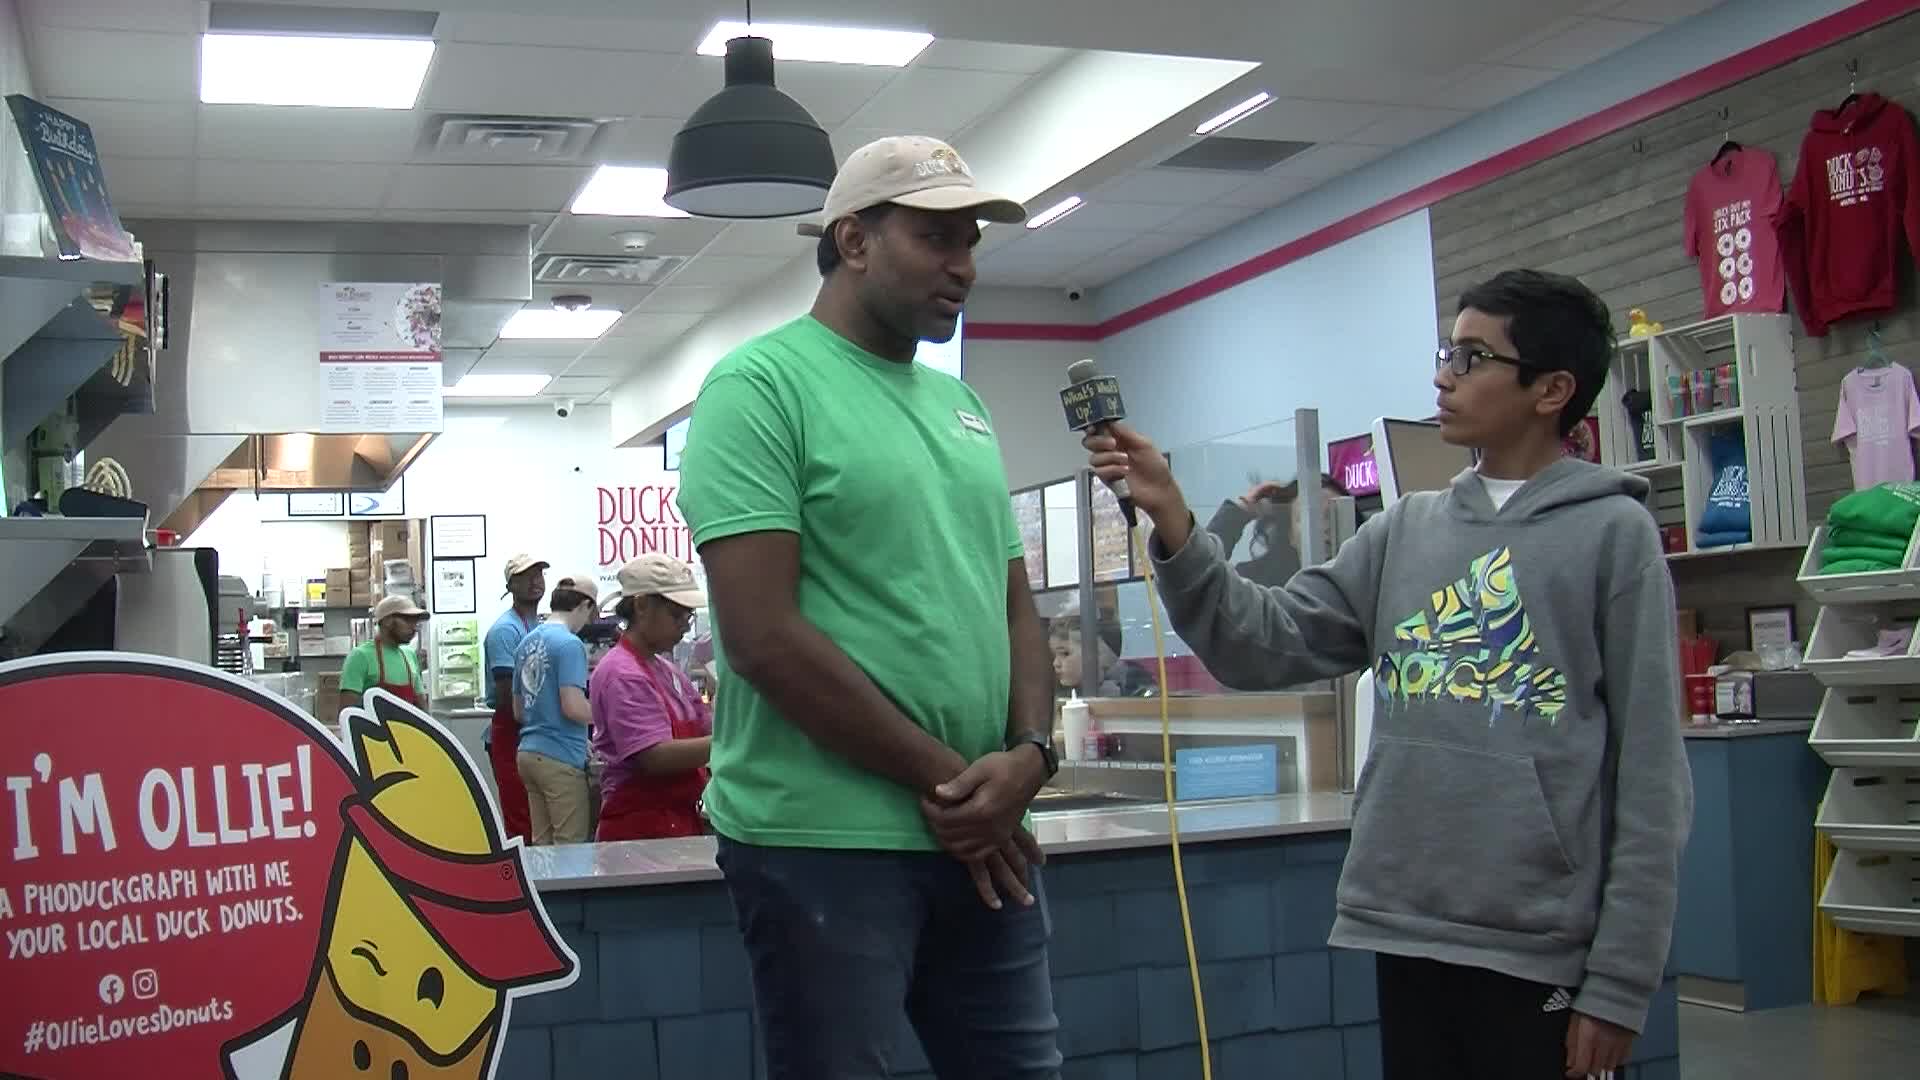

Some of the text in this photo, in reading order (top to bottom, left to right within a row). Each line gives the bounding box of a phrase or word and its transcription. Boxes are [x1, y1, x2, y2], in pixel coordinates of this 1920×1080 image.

[1828, 167, 1867, 193] DONUS
[1730, 209, 1751, 228] PACK
[1345, 460, 1375, 490] DUCK
[597, 485, 680, 525] DUCK
[597, 526, 695, 566] DONUT
[6, 744, 317, 861] I'M OLLIE!
[24, 869, 198, 916] PHODUCKGRAPH
[205, 863, 257, 897] WITH
[264, 860, 293, 888] ME
[7, 895, 304, 960] YOUR LOCAL DUCK DONUTS.
[23, 997, 234, 1054] #OllieLovesDonuts
